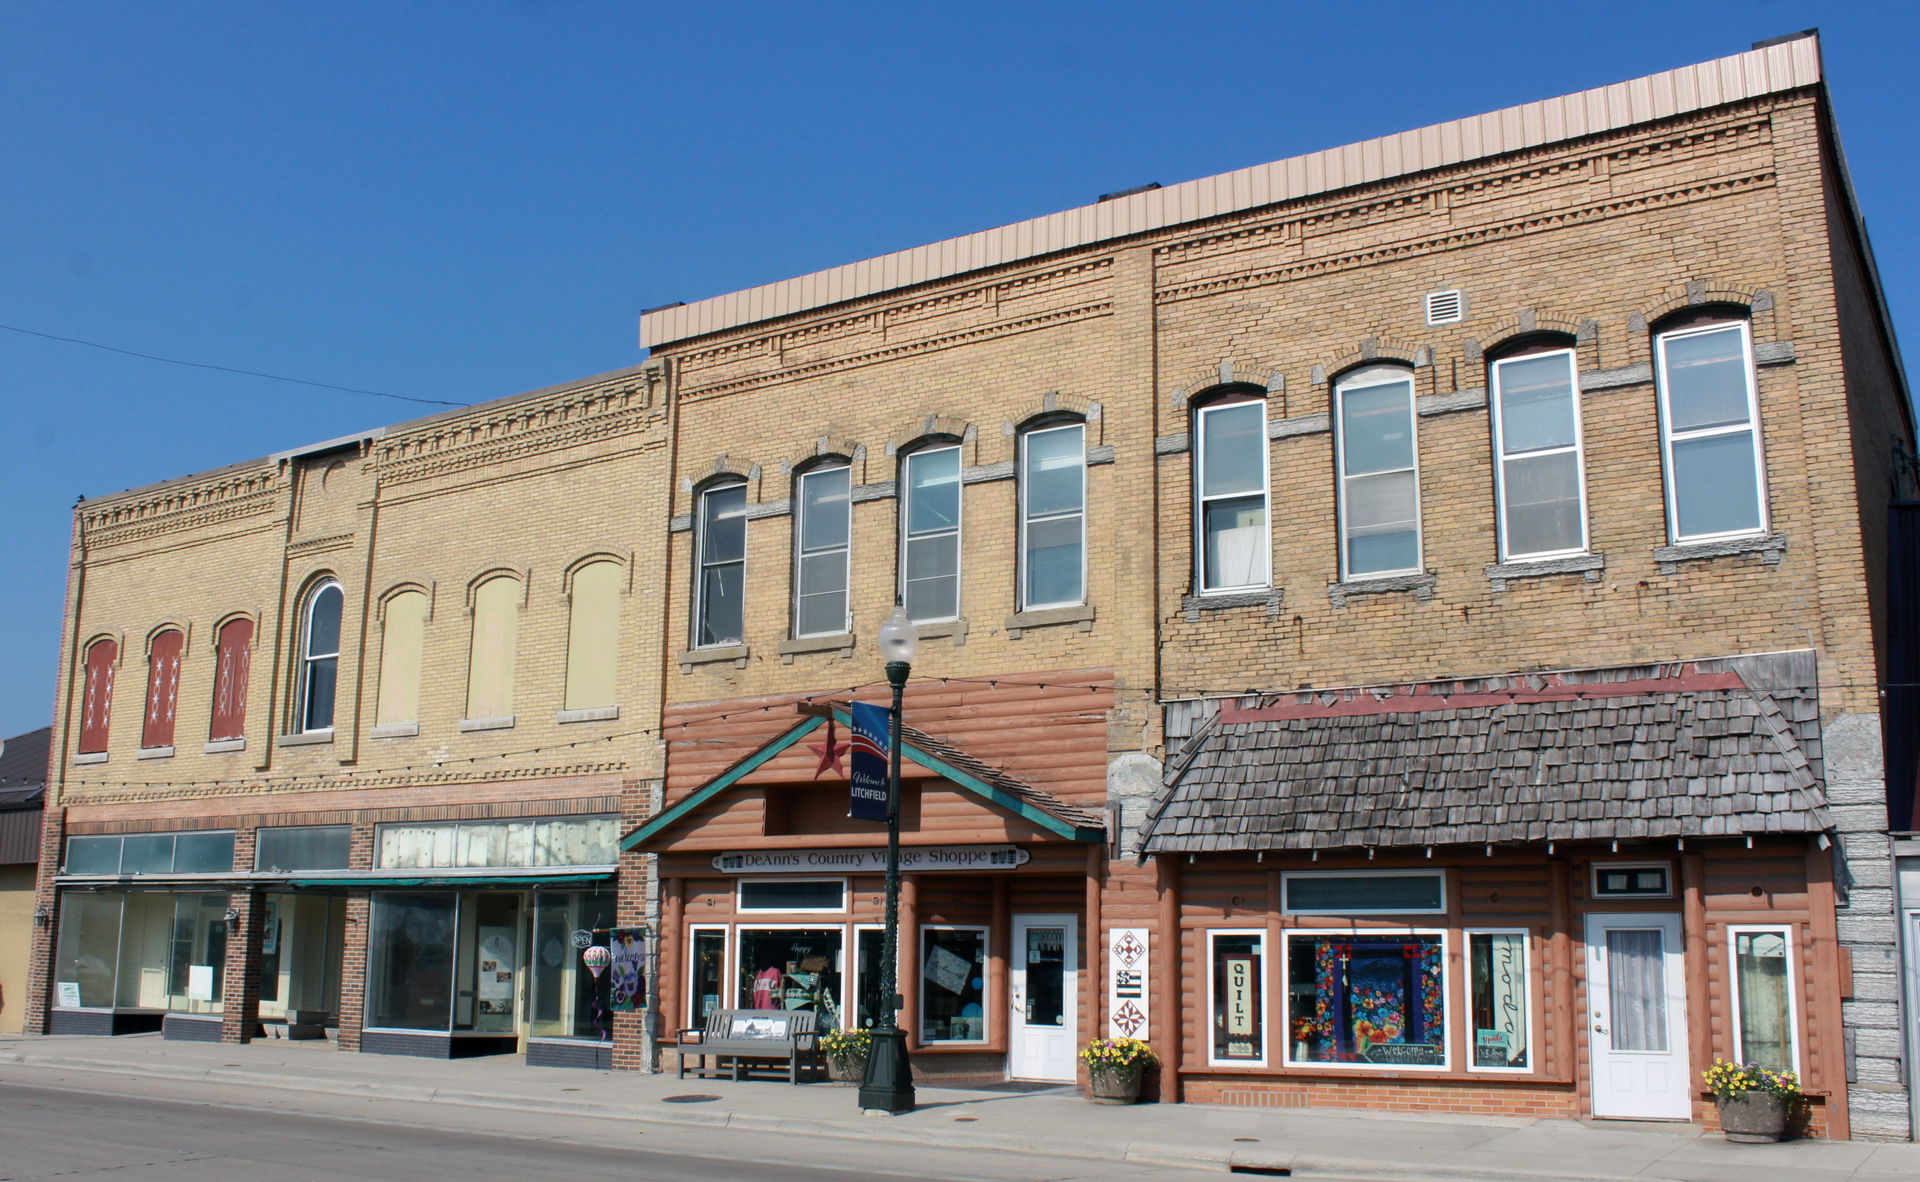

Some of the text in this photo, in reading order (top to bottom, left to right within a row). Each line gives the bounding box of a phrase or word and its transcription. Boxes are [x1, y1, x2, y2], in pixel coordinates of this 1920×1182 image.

[852, 771, 880, 785] Welcome
[851, 786, 887, 802] LITCHFIELD
[745, 850, 987, 867] DeAnn's Country Vige Shoppe
[572, 935, 592, 945] OPEN
[1233, 963, 1245, 1027] QUILT
